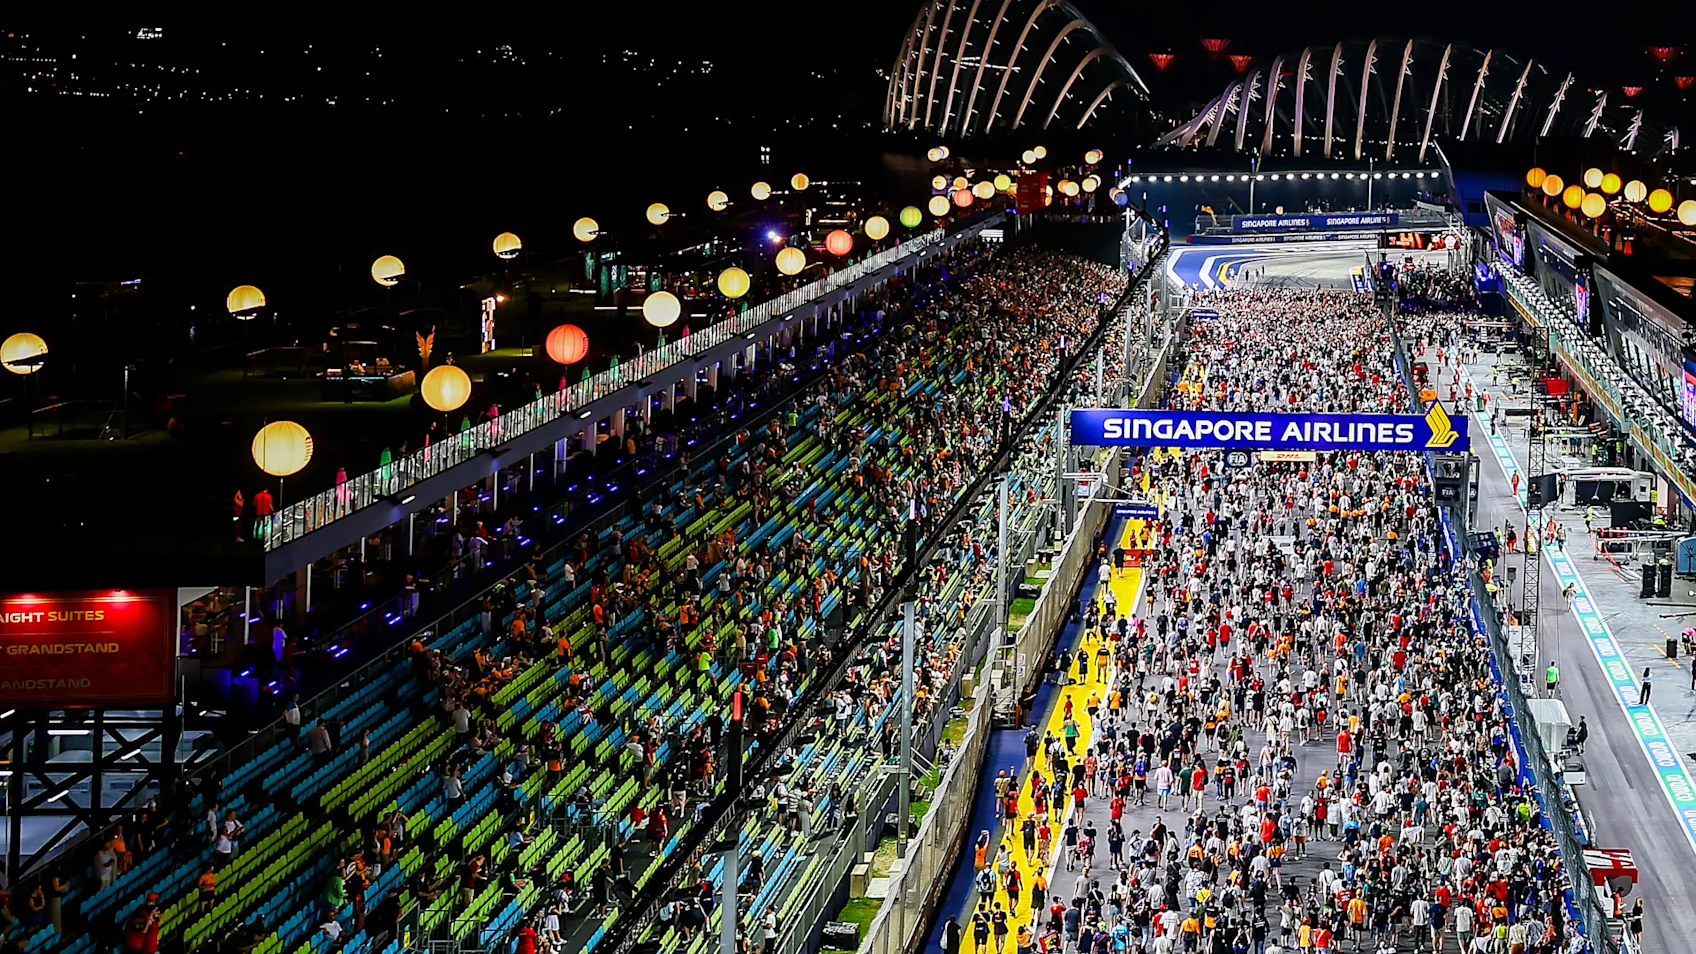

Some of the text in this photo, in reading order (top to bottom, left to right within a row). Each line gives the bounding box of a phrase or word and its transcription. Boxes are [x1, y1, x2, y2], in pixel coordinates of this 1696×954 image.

[1241, 219, 1306, 229] SINGAPORE AIRLINES
[1326, 217, 1359, 226] SINGAPORE
[1102, 417, 1414, 444] SINGAPORE AIRLINES
[47, 610, 105, 622] SUITES
[6, 643, 120, 656] GRANDSTAND
[1648, 741, 1677, 767] aramco
[1665, 773, 1695, 802] aramco
